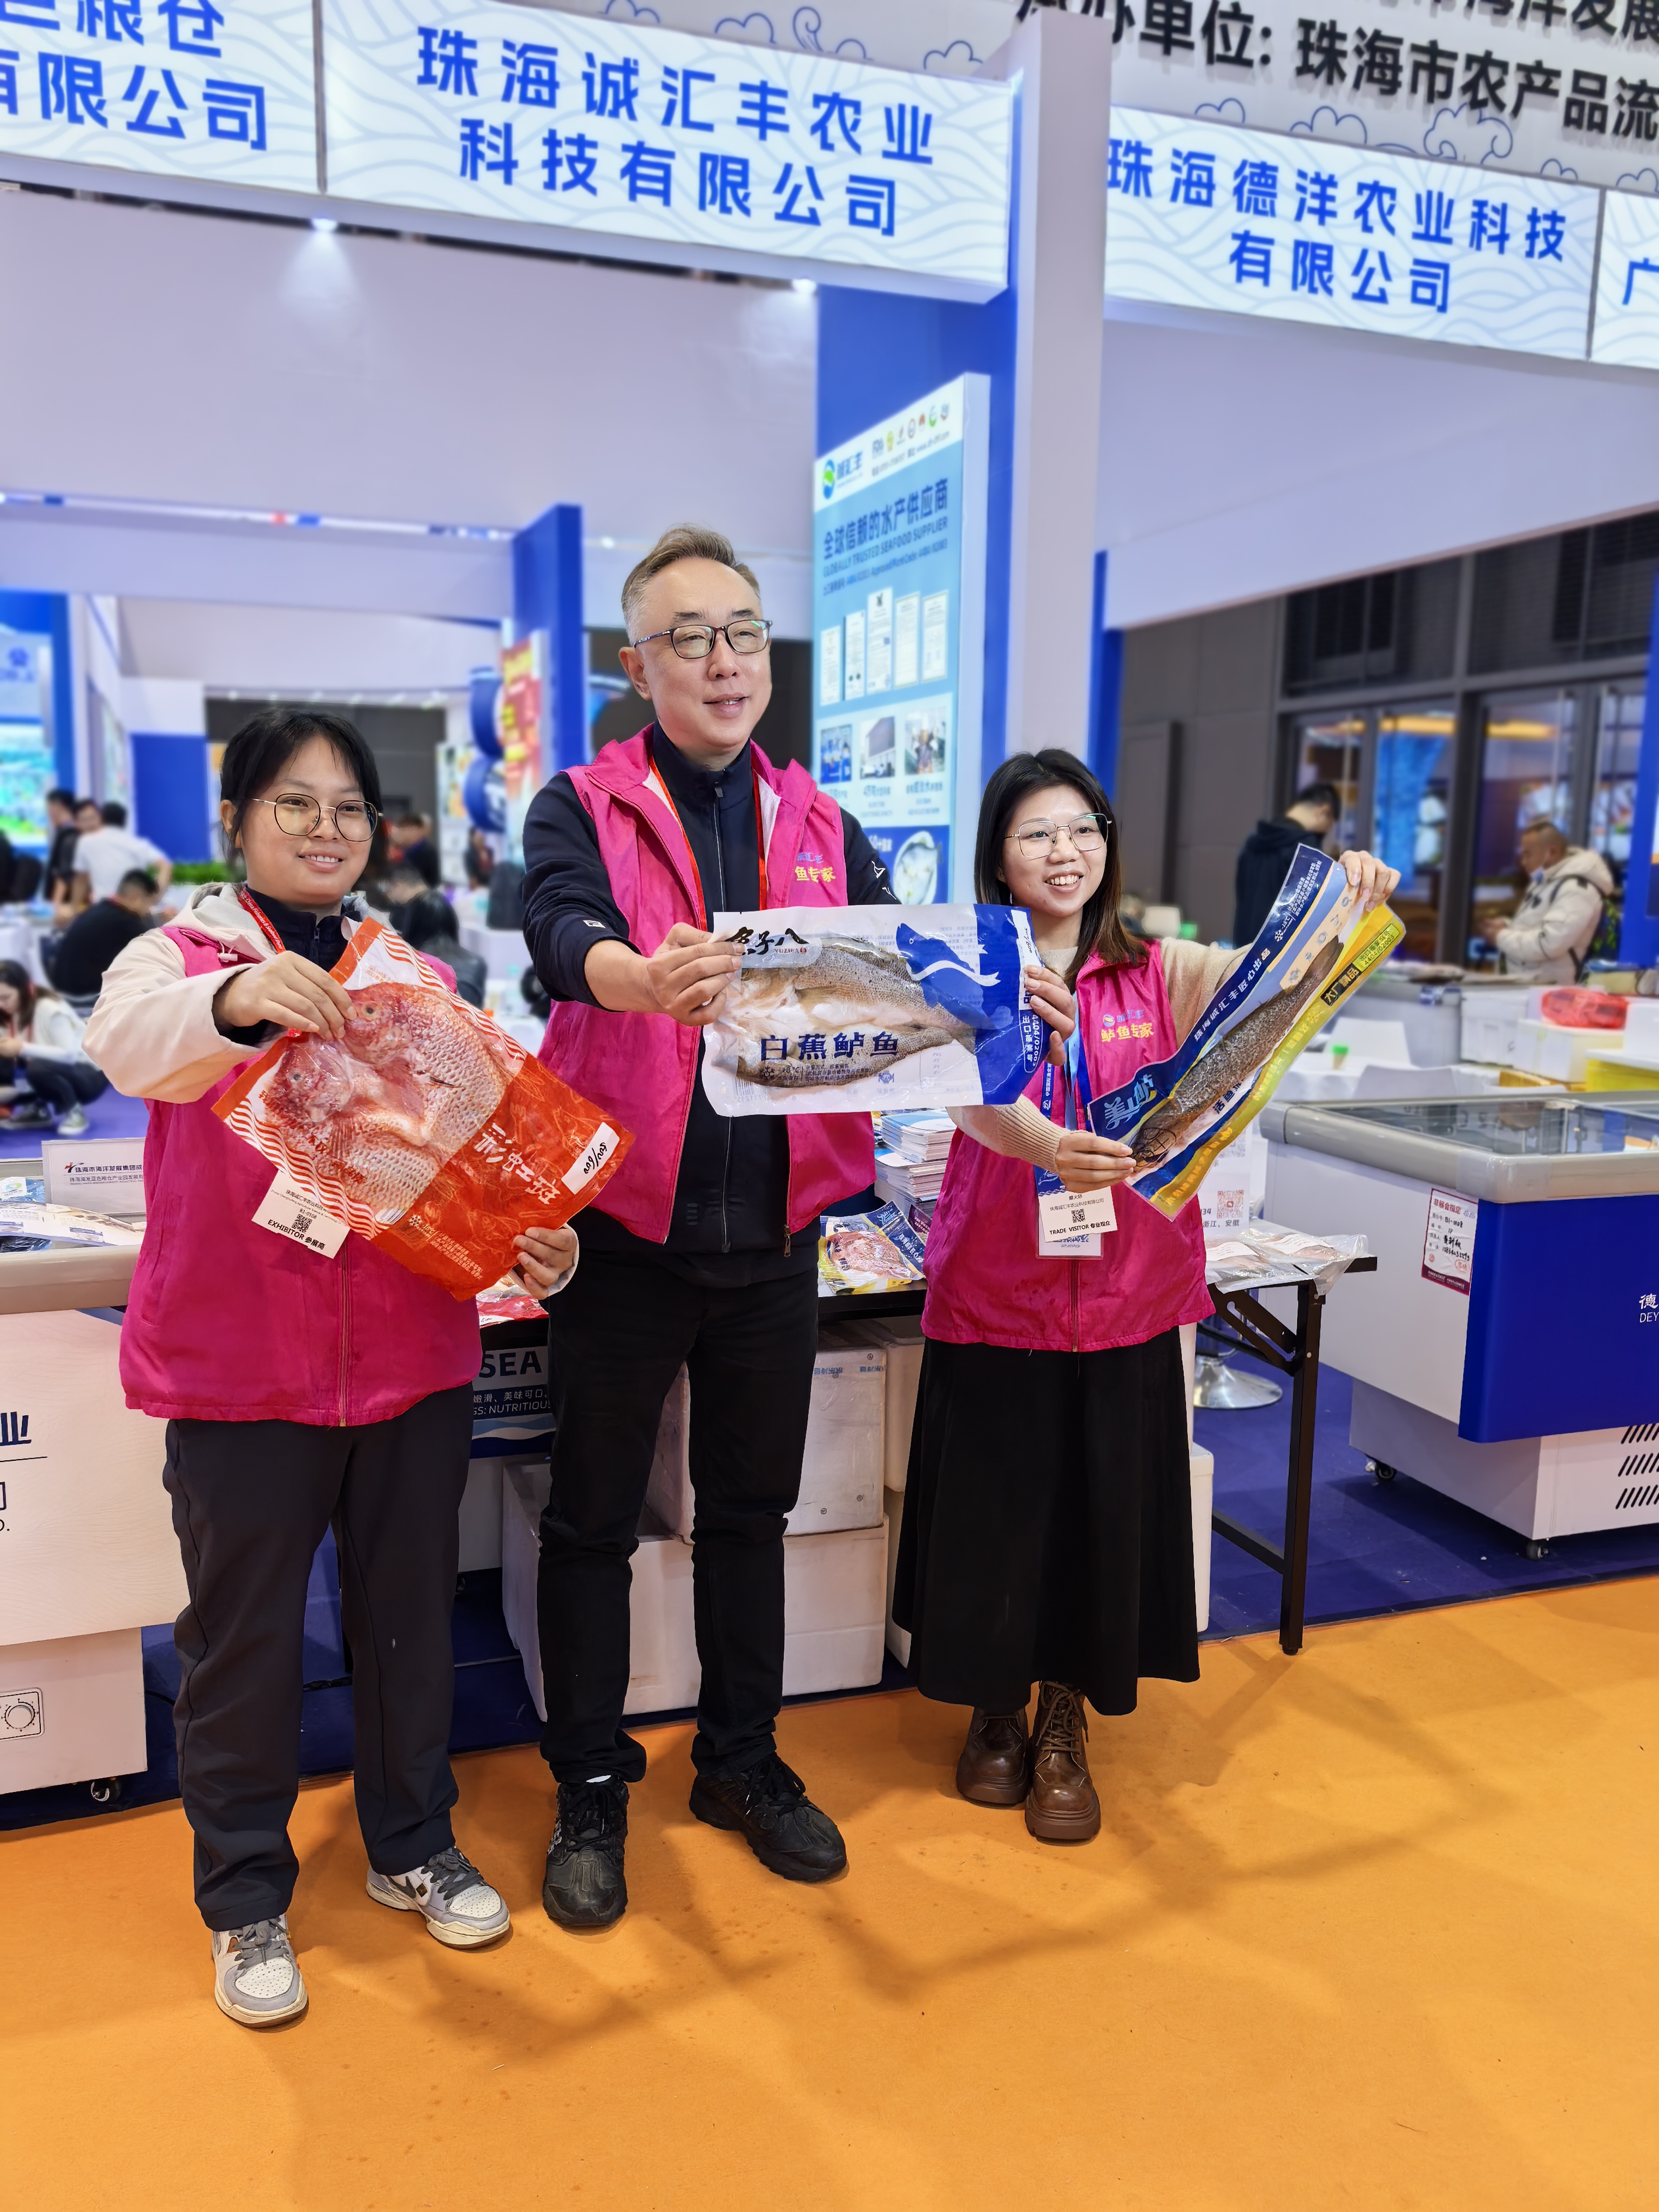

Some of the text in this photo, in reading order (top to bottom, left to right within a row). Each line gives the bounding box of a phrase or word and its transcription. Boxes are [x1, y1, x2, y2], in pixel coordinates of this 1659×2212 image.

[417, 26, 934, 165] 珠海诚汇丰农业
[460, 118, 896, 237] 科技有限公司
[1106, 138, 1567, 263] 珠海德洋农业科技
[1229, 230, 1451, 314] 有限公司
[853, 544, 880, 565] TRUSTED
[881, 531, 912, 555] SEAFOOD
[913, 515, 948, 542] SUPPLIER
[760, 1031, 899, 1062] 白蕉鲈鱼
[1101, 1022, 1155, 1043] 鲈鱼专家
[267, 1219, 326, 1250] EXHIBITOR 参展商
[1068, 1224, 1090, 1232] VISITOR
[478, 1350, 542, 1378] SEA
